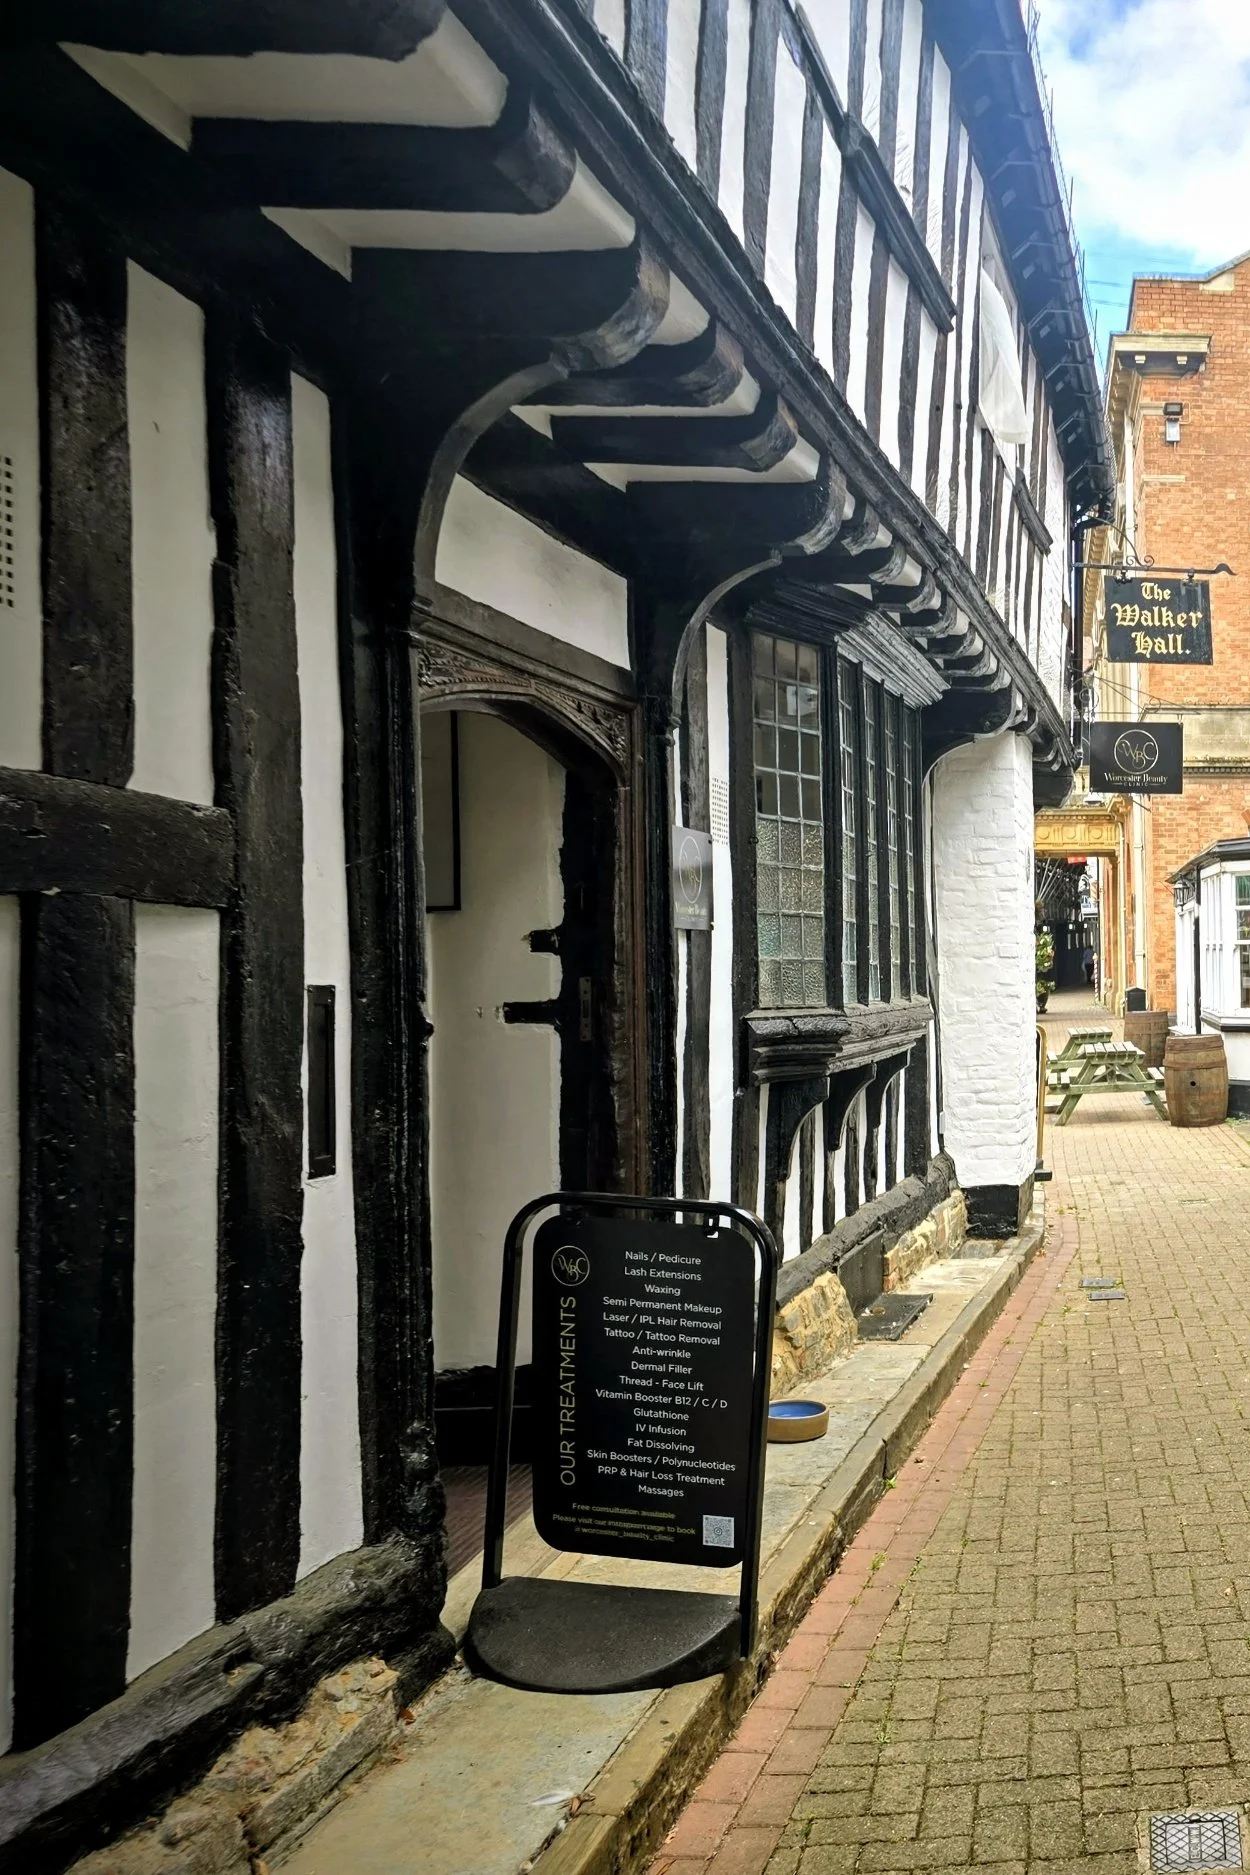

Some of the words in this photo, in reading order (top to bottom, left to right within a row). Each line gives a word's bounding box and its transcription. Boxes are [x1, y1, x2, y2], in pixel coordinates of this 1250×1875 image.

[1141, 582, 1171, 601] The
[1110, 603, 1203, 628] Walker
[1131, 631, 1191, 658] Hall.
[1104, 772, 1142, 782] Worcester
[1143, 774, 1168, 785] Beauty
[625, 1251, 648, 1261] Nails
[651, 1252, 657, 1262] /
[659, 1254, 701, 1265] Pedicure
[624, 1267, 647, 1277] Lash
[650, 1268, 702, 1281] Extensions
[644, 1284, 681, 1296] Waxing
[603, 1297, 627, 1306] Semi
[630, 1299, 681, 1311] Permanent
[684, 1303, 722, 1315] Makeup
[603, 1312, 629, 1322] Laser
[631, 1314, 637, 1324] /
[639, 1315, 656, 1325] IPL
[658, 1316, 677, 1326] Hair
[680, 1319, 722, 1330] Removal
[604, 1328, 635, 1339] Tattoo
[637, 1330, 643, 1340] /
[645, 1330, 676, 1342] Tattoo
[679, 1334, 720, 1345] Removal
[632, 1346, 691, 1359] Anti-wrinkle
[560, 1296, 576, 1435] TREATMENTS
[631, 1361, 666, 1372] Dermal
[668, 1364, 692, 1374] Filler
[619, 1375, 652, 1387] Thread
[662, 1379, 685, 1389] Face
[688, 1382, 704, 1391] Lift
[596, 1389, 632, 1400] Vitamin
[635, 1393, 672, 1404] Booster
[675, 1396, 691, 1405] B12
[693, 1397, 700, 1407] /
[702, 1398, 710, 1407] C
[712, 1399, 718, 1408] /
[720, 1399, 728, 1408] D
[633, 1408, 689, 1421] Glutathione
[636, 1423, 646, 1432] IV
[648, 1425, 687, 1436] Infusion
[628, 1438, 643, 1448] Fat
[646, 1440, 695, 1453] Dissolving
[560, 1441, 576, 1486] OUR
[587, 1449, 608, 1459] Skin
[610, 1452, 652, 1463] Boosters
[654, 1455, 660, 1465] /
[662, 1456, 736, 1472] Polynucleotides
[598, 1466, 618, 1475] PRP
[620, 1468, 627, 1476] &
[630, 1468, 649, 1478] Hair
[652, 1471, 673, 1481] Loss
[675, 1473, 725, 1486] Treatment
[638, 1485, 684, 1497] Massages
[592, 1505, 640, 1515] consultation
[553, 1514, 576, 1522] Please
[577, 1516, 593, 1524] visit
